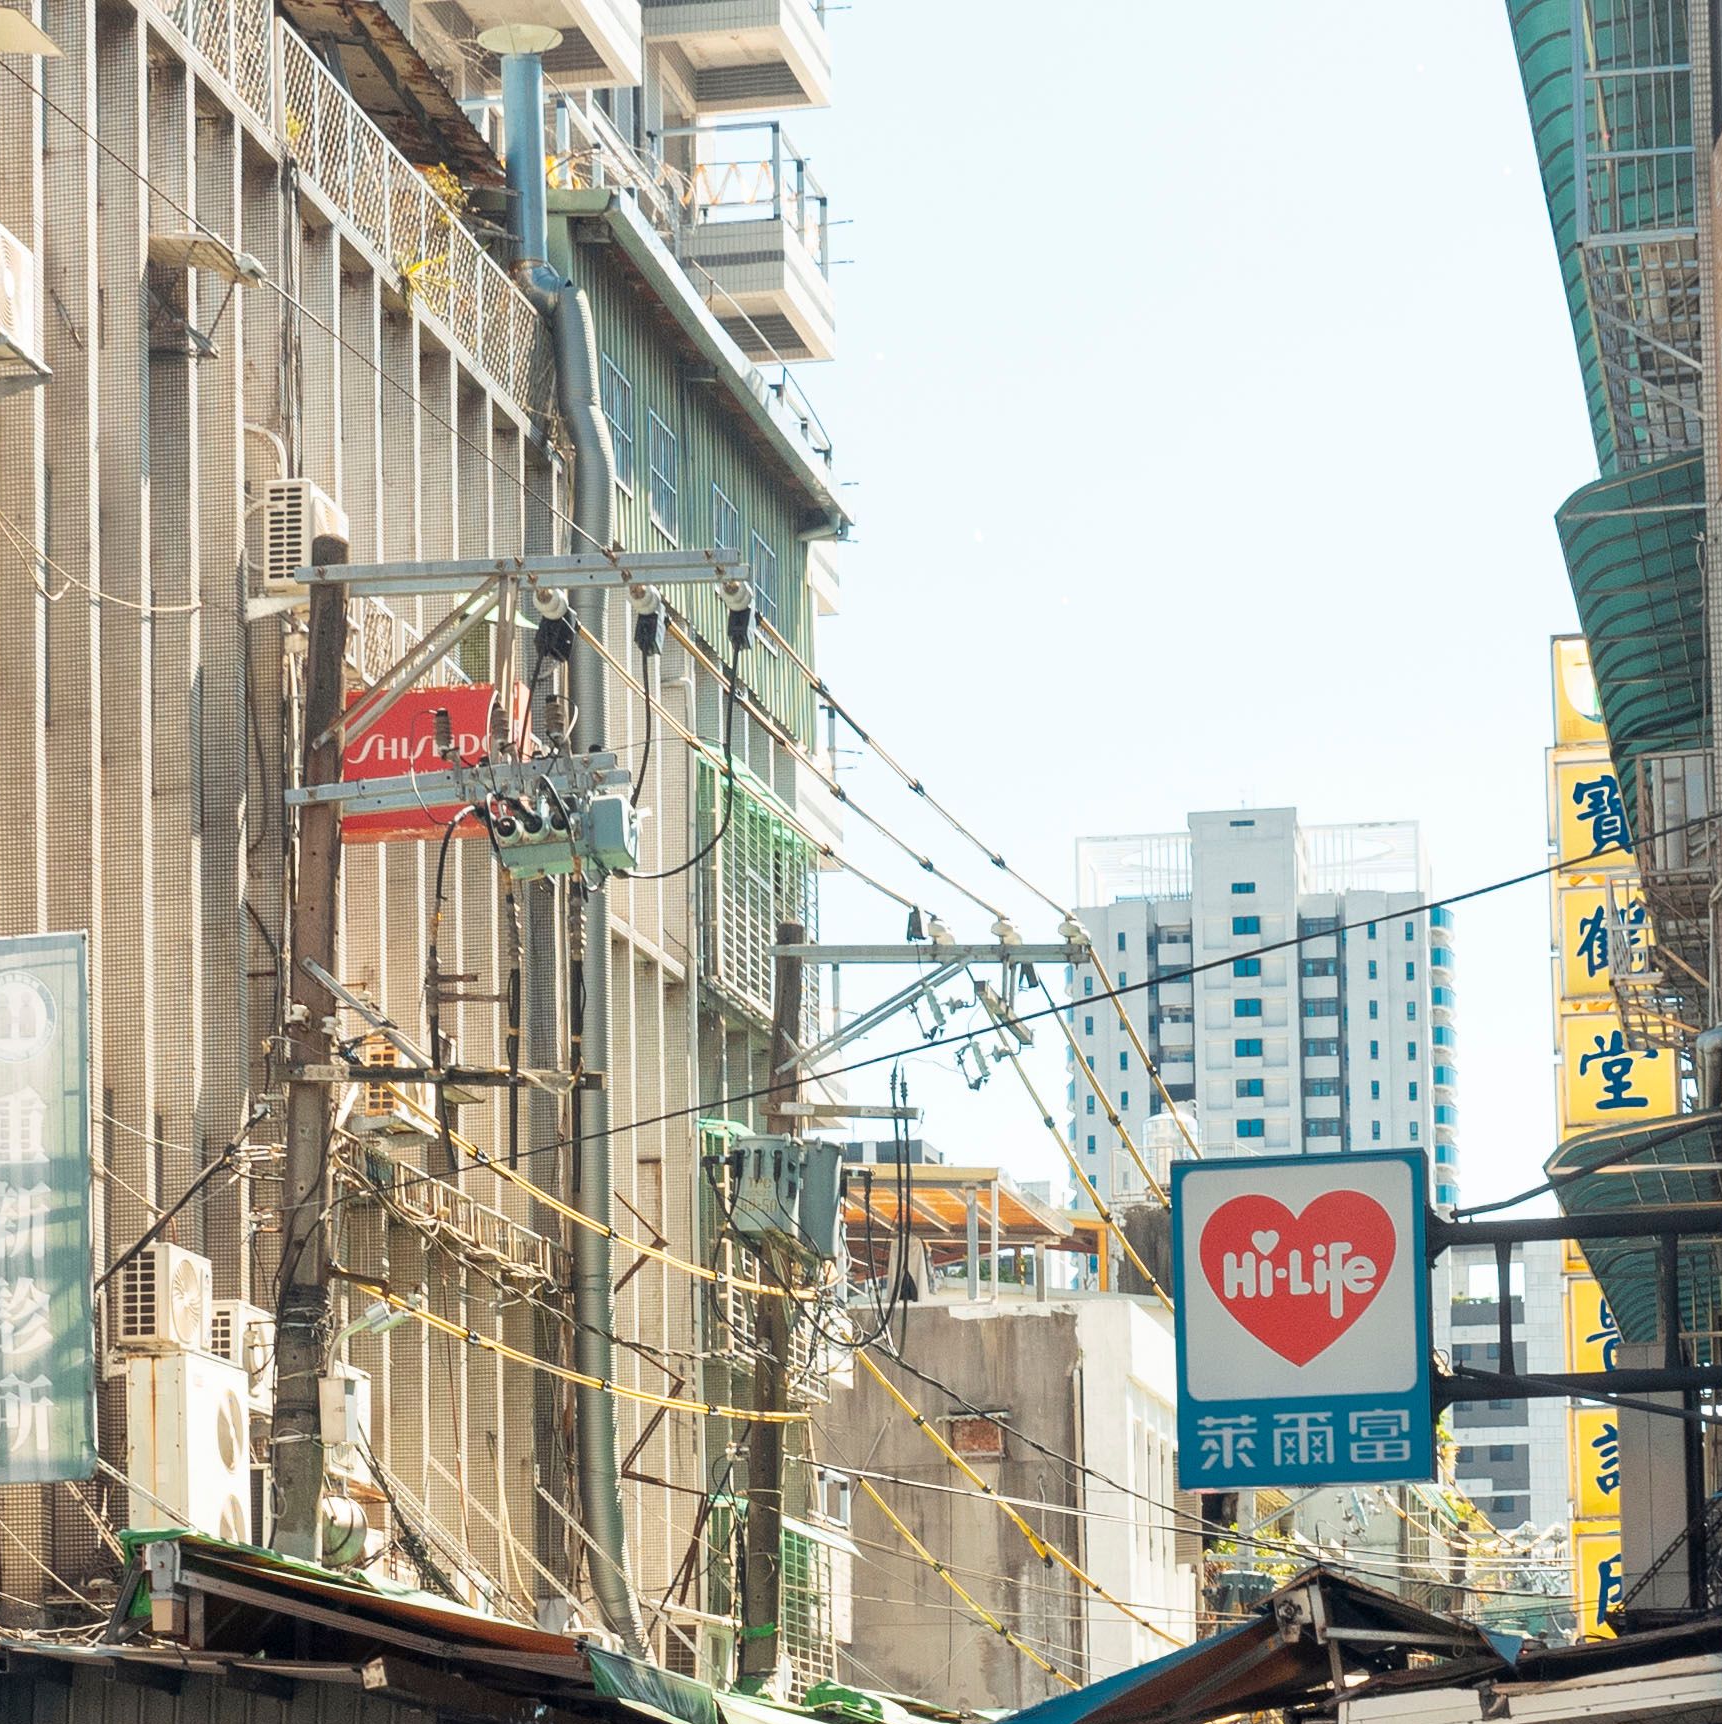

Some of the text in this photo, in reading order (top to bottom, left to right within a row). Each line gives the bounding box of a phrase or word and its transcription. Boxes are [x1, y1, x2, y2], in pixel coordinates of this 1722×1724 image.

[1222, 1229, 1377, 1320] Hi-Life
[1196, 1408, 1411, 1471] 萊爾富
